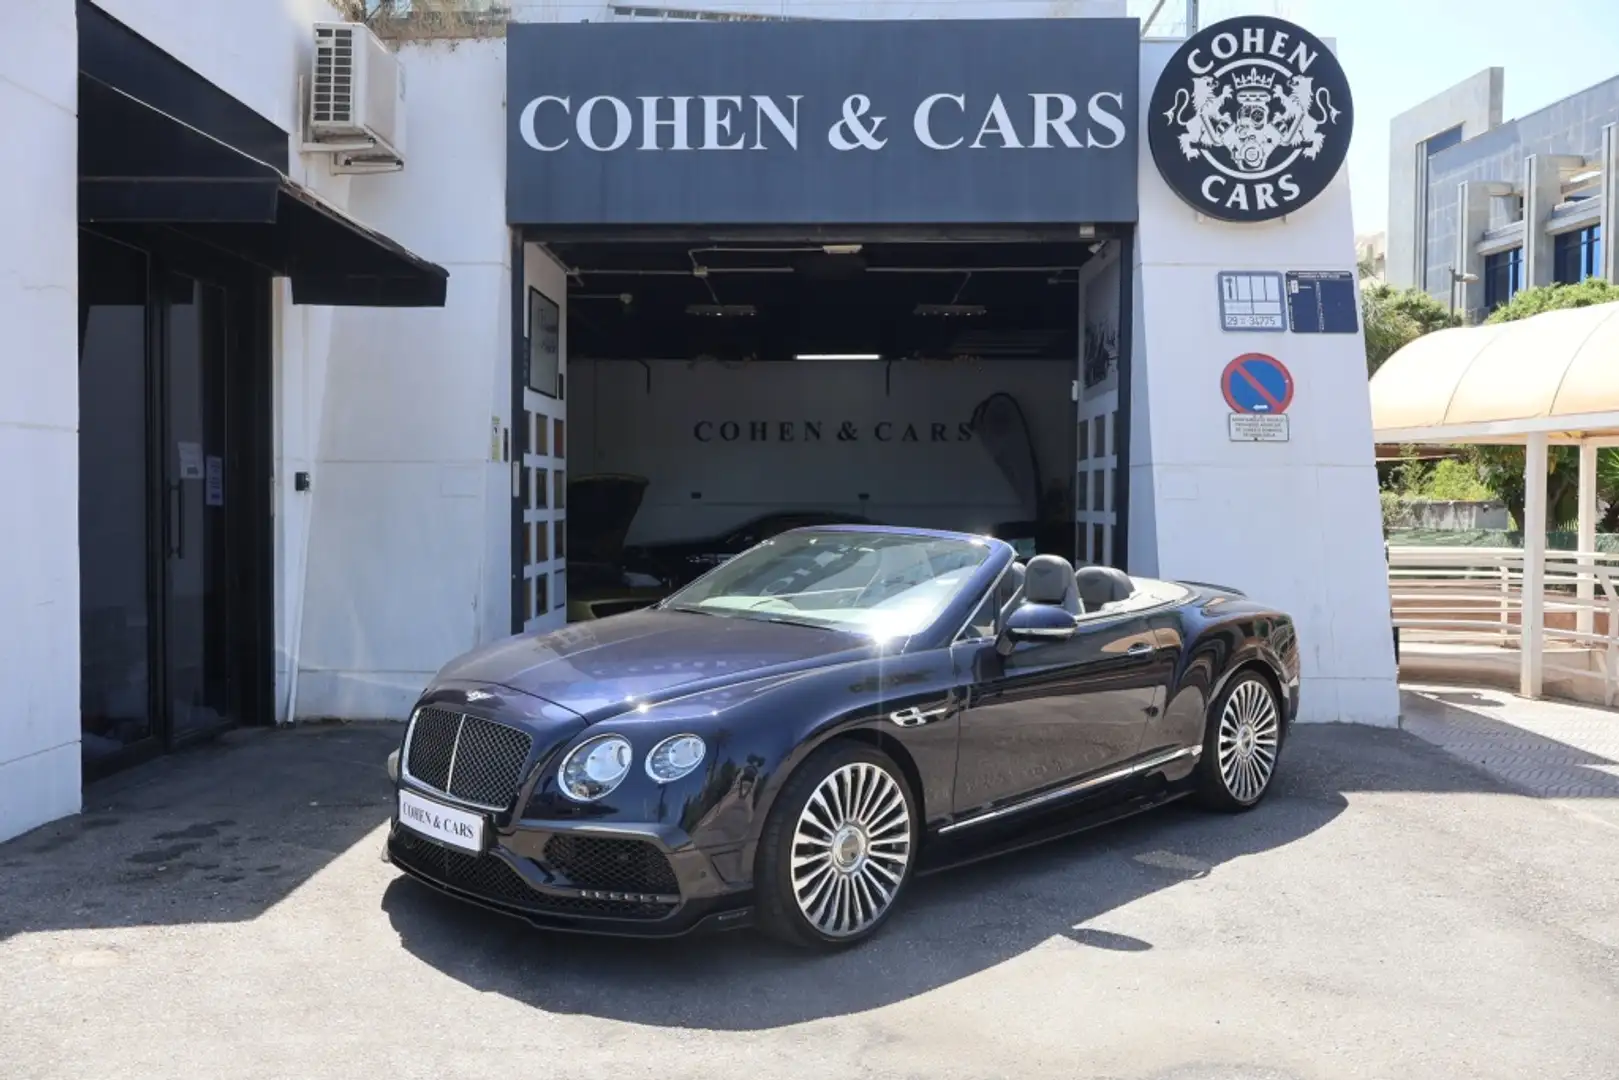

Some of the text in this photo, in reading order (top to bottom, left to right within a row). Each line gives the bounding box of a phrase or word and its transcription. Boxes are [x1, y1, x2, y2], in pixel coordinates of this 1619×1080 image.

[1187, 28, 1318, 75] COHEN
[519, 92, 1126, 152] COHEN & CARS
[1201, 173, 1300, 211] CARS
[693, 420, 973, 443] COHEN & CARS
[403, 802, 474, 839] COHEN & CARS
